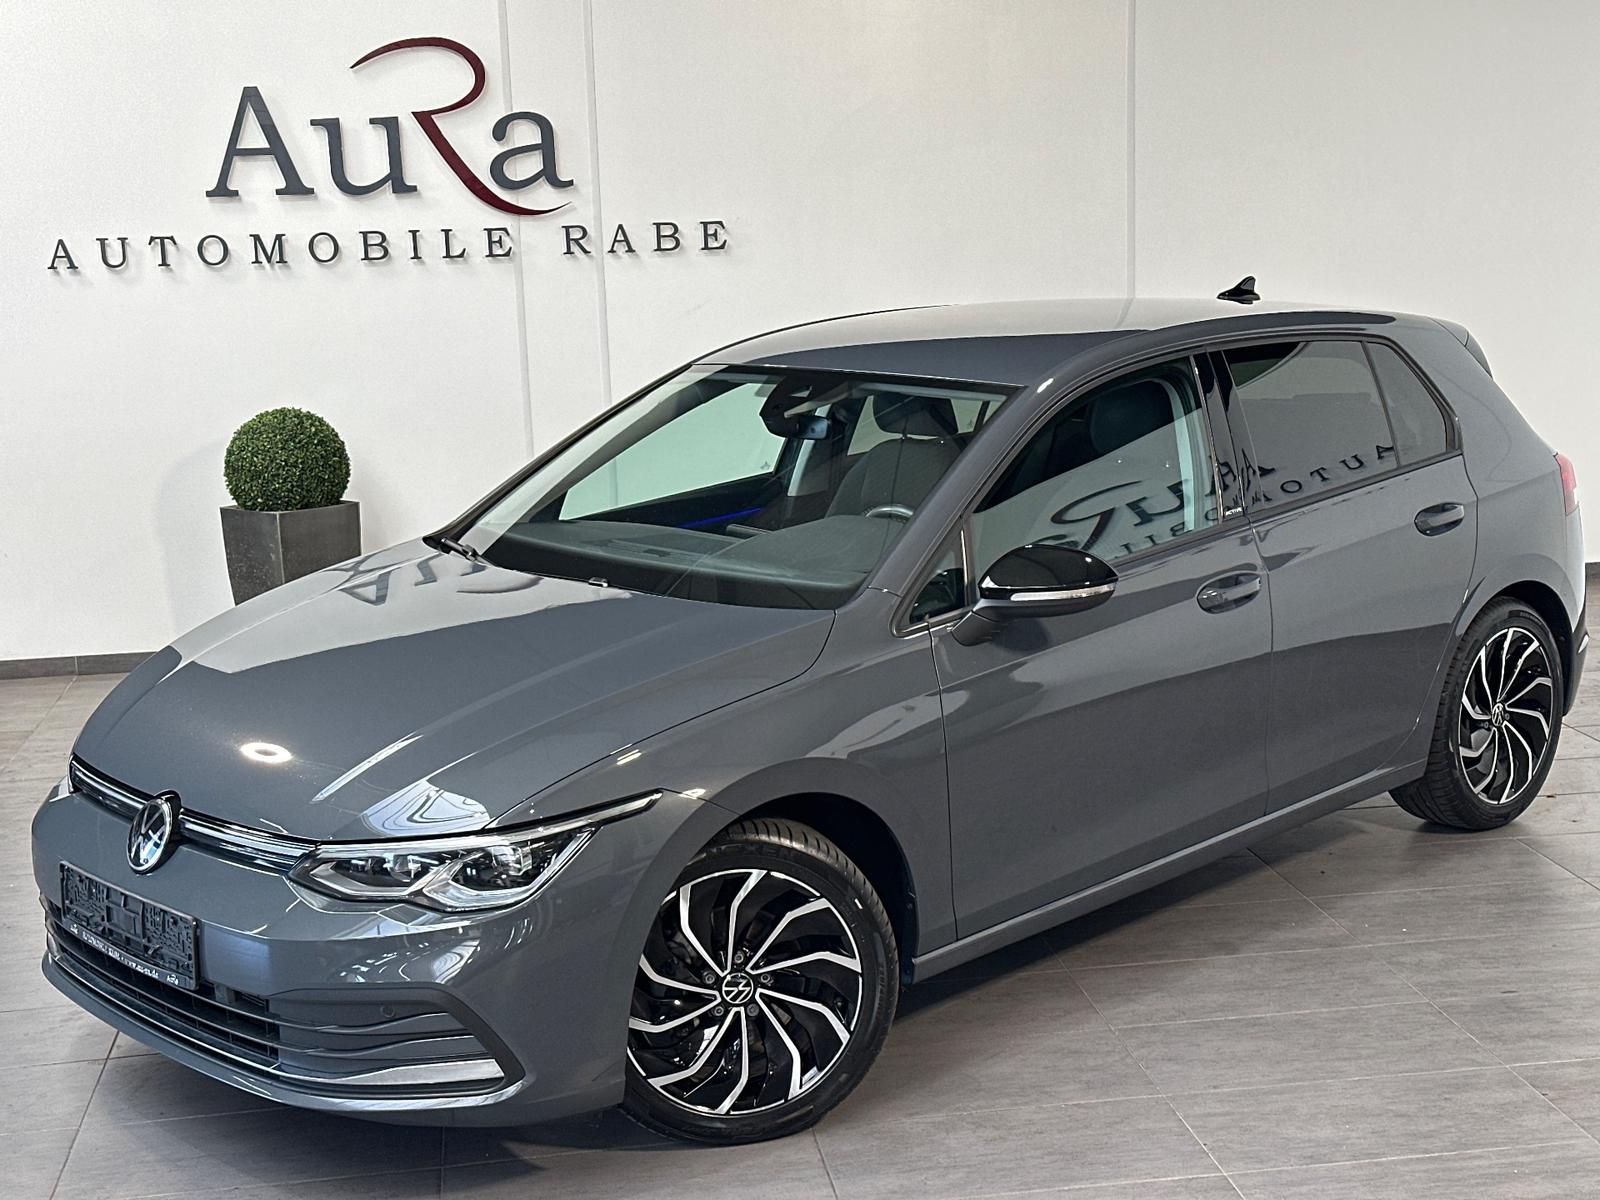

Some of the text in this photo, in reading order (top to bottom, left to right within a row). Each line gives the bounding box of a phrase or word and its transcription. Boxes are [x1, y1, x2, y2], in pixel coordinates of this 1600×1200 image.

[206, 37, 574, 216] AuRa
[47, 220, 728, 270] AUTOMOBILE RABE
